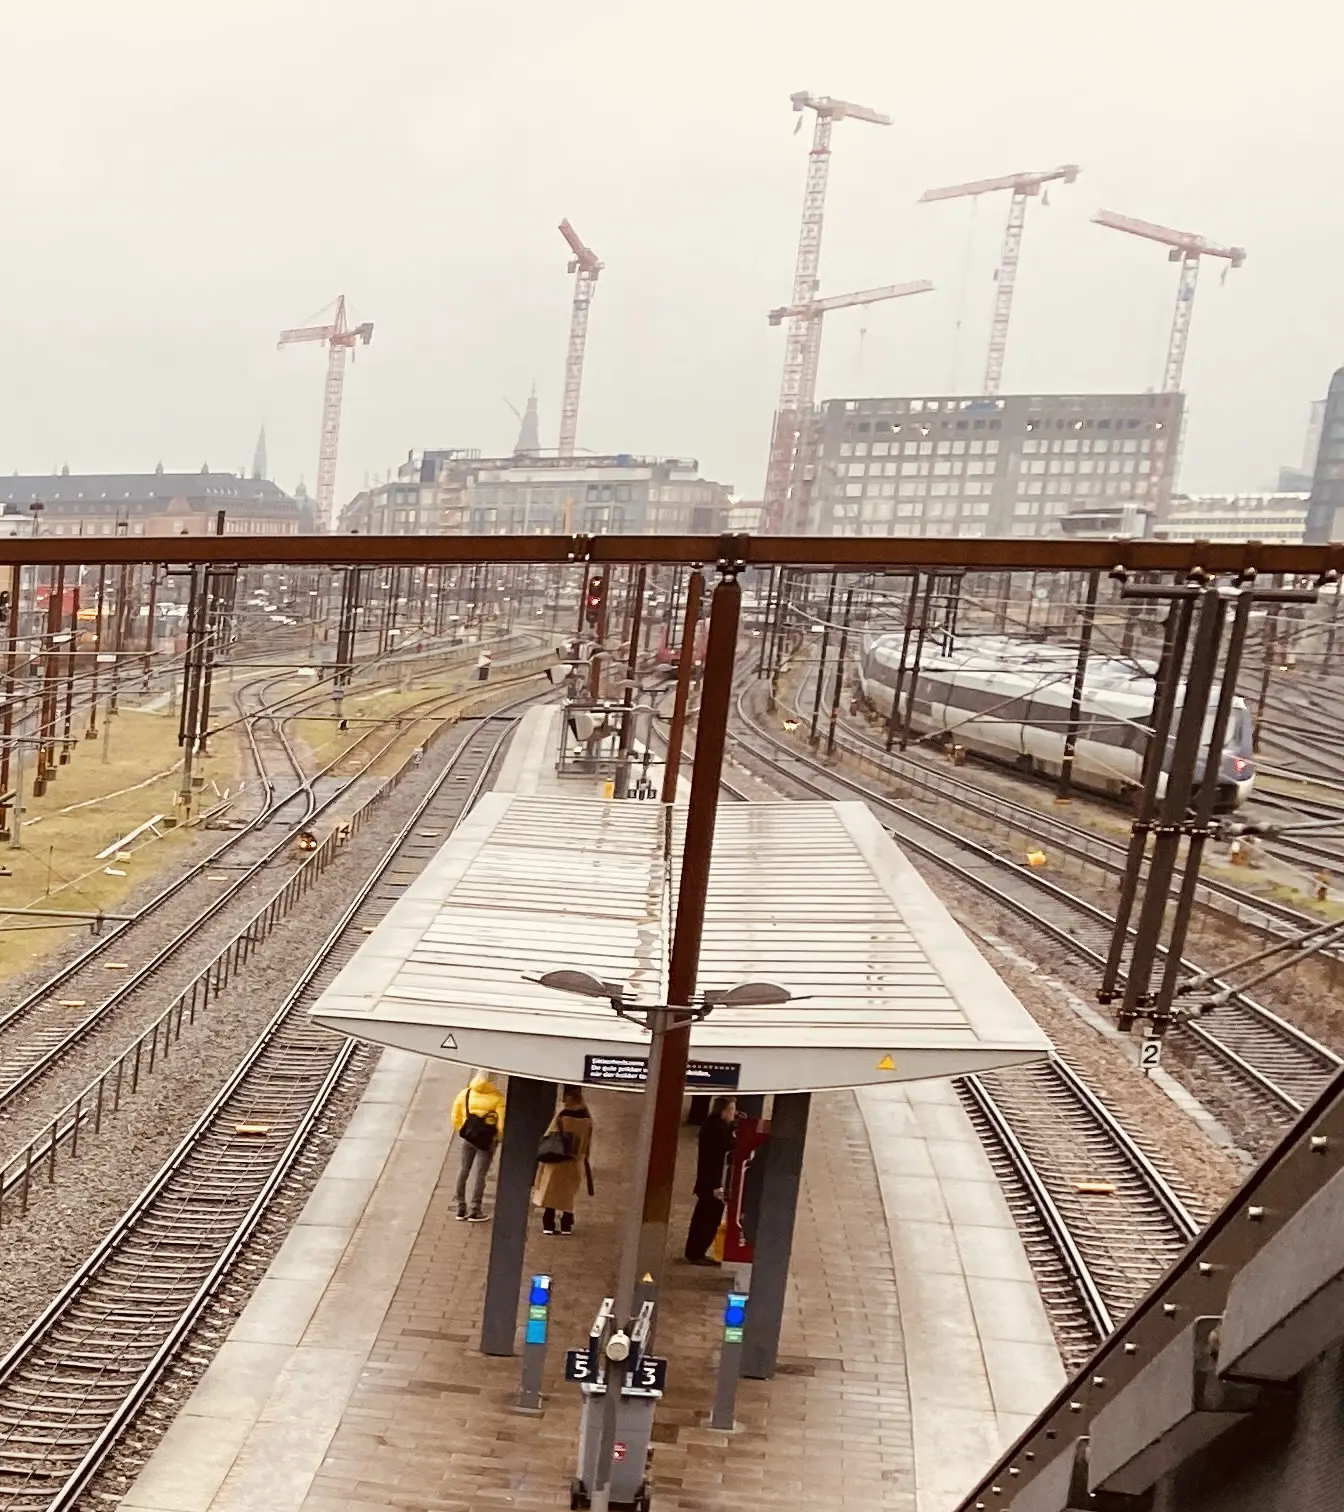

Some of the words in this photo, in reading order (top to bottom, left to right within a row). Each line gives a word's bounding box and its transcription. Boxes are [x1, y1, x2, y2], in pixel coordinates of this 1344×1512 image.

[1144, 1044, 1159, 1065] 2
[573, 1360, 588, 1378] 5
[641, 1367, 656, 1385] 3
